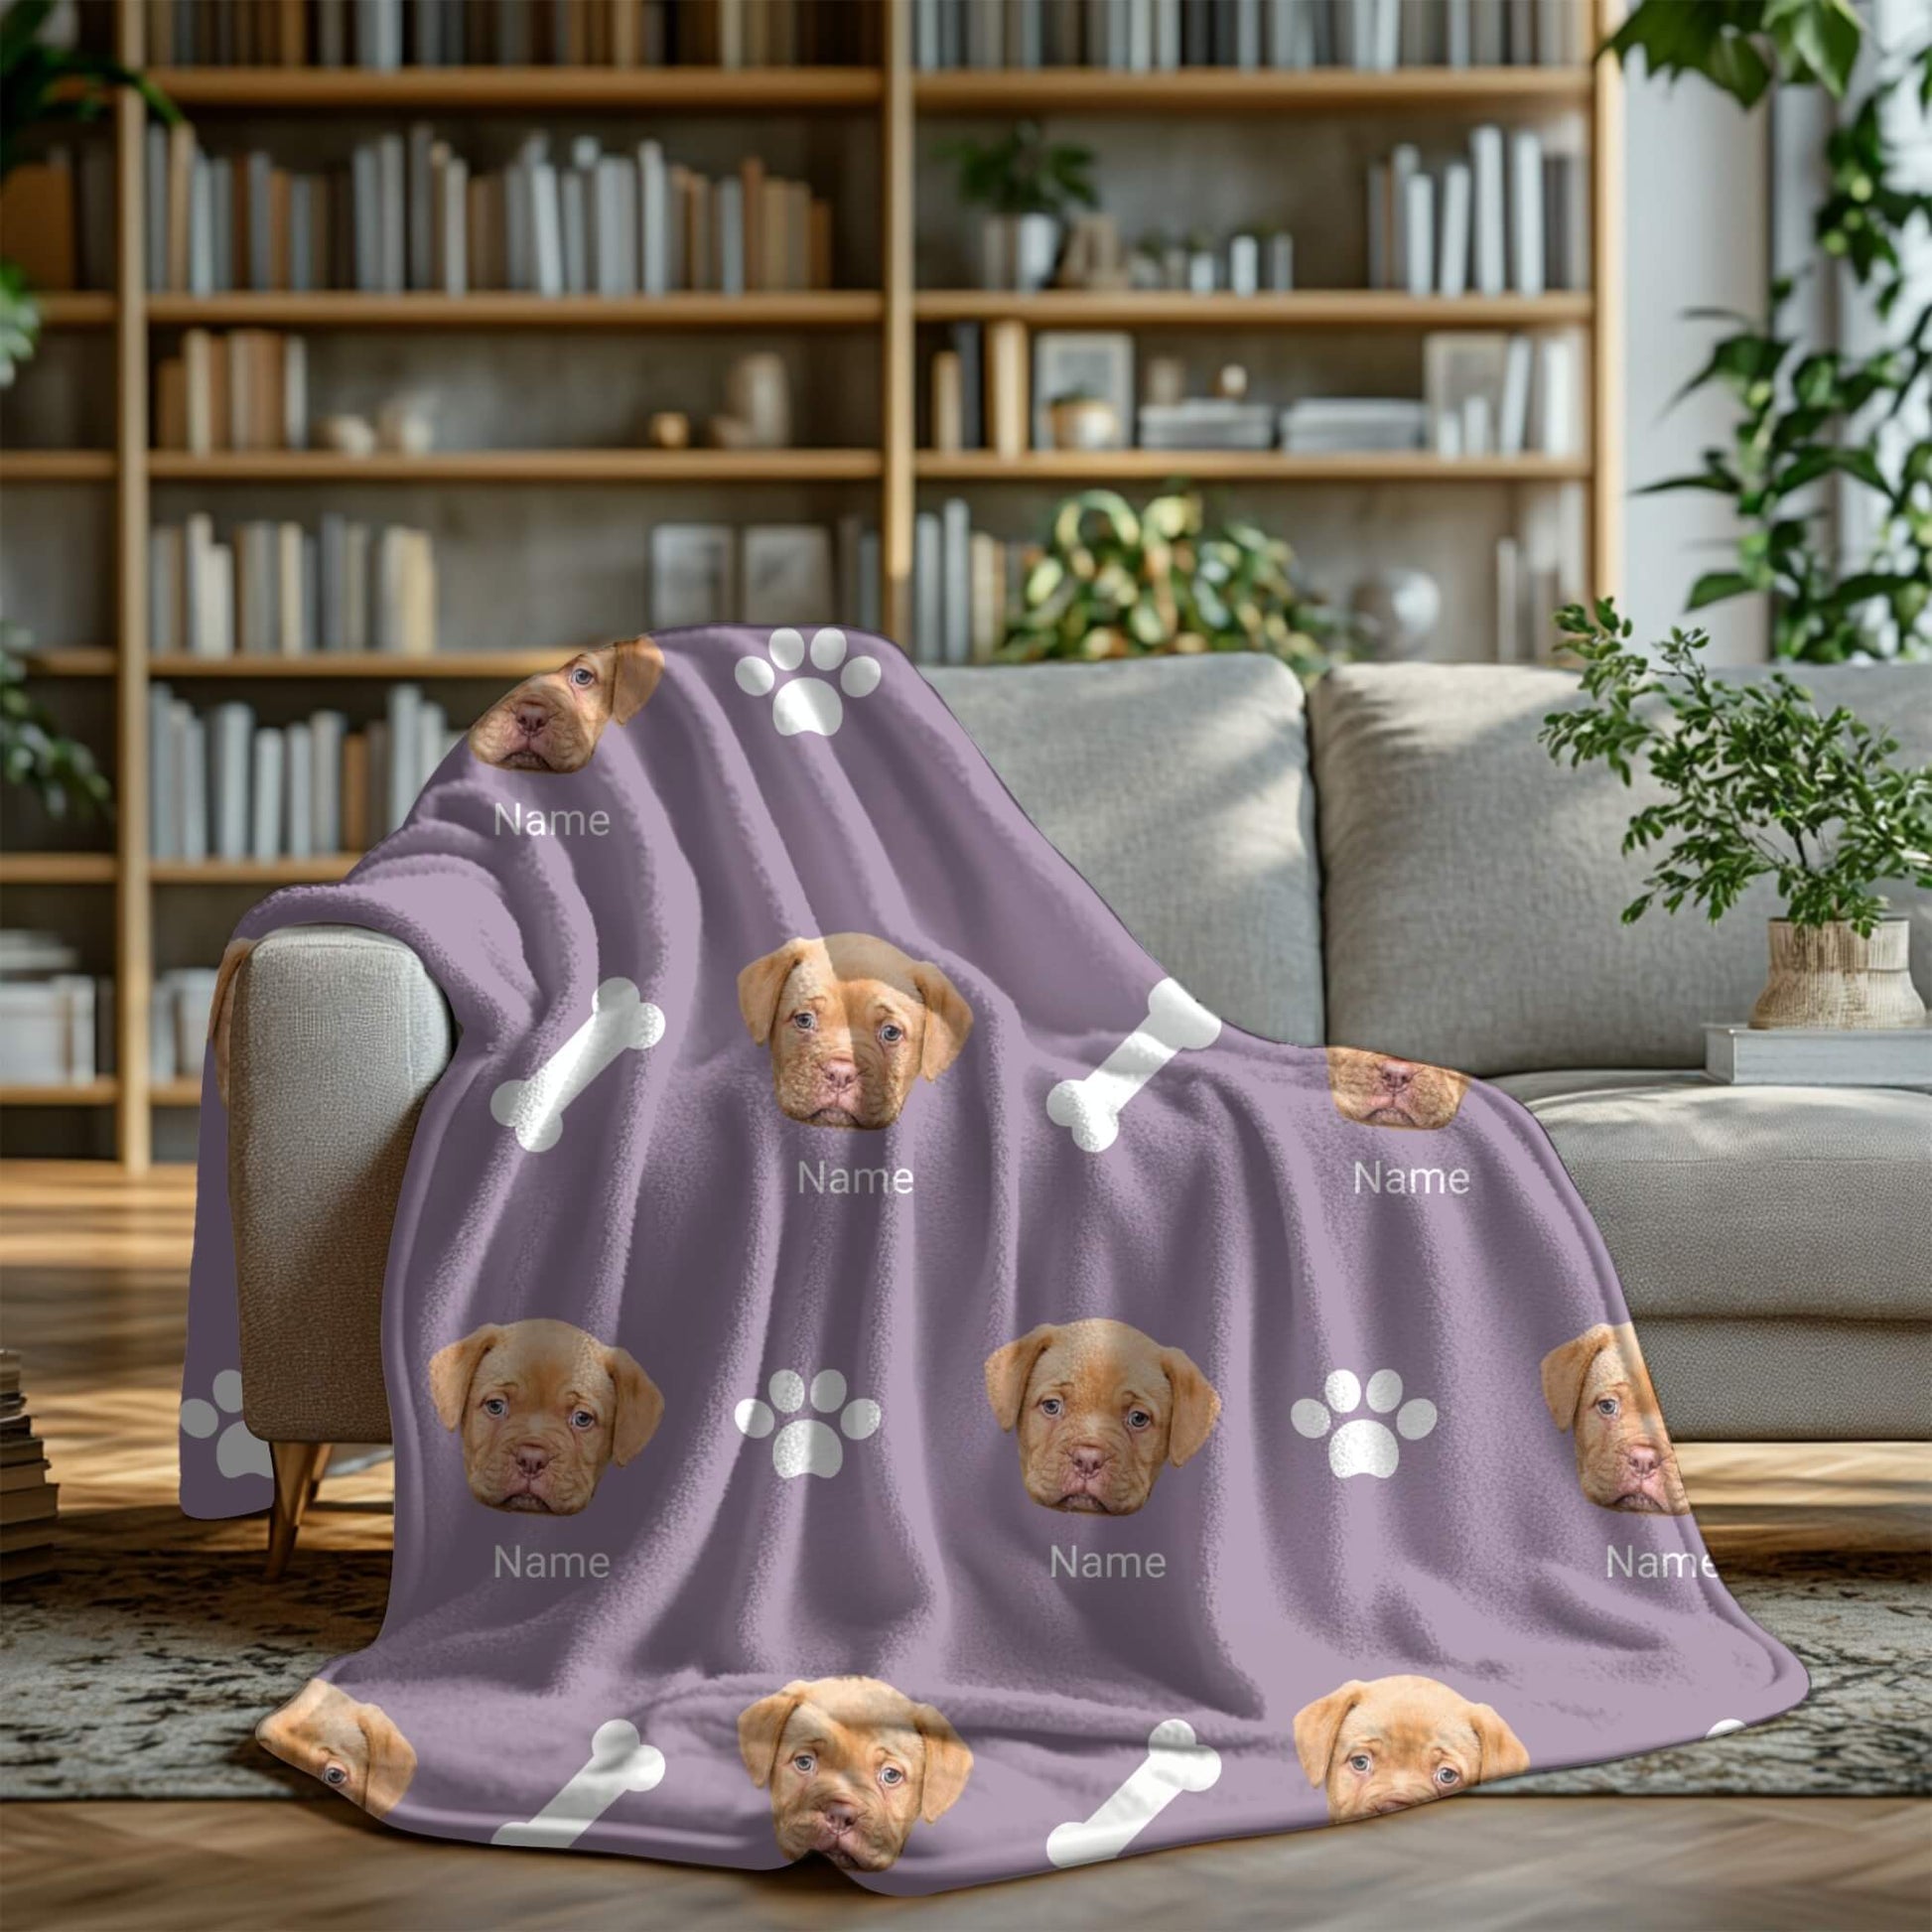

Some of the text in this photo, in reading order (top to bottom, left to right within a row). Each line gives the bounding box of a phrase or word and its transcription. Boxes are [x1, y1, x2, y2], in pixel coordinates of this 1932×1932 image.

[494, 802, 611, 836] Name
[799, 1161, 914, 1194] Name
[1354, 1161, 1470, 1194] Name
[493, 1545, 610, 1579] Name
[1050, 1545, 1167, 1579] Name
